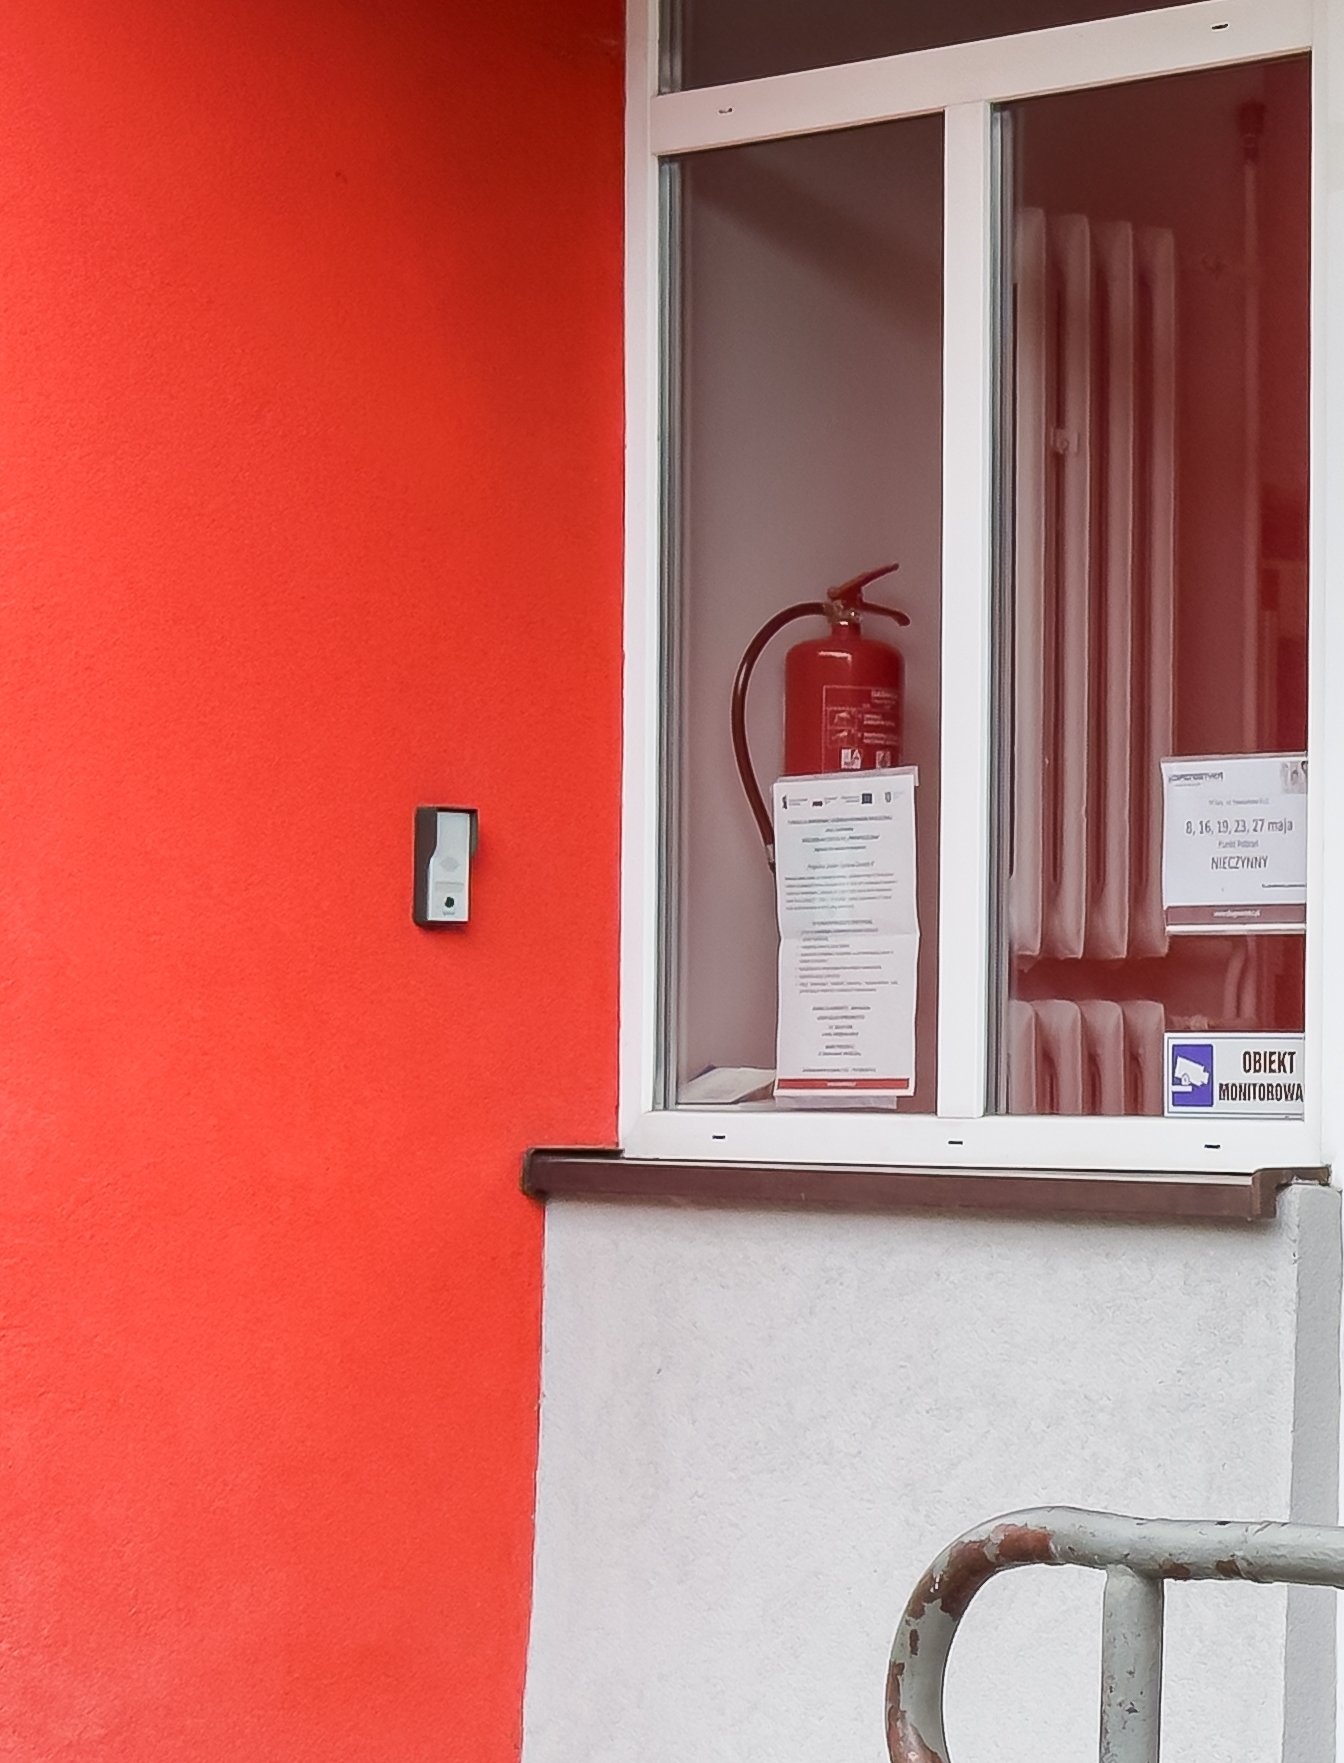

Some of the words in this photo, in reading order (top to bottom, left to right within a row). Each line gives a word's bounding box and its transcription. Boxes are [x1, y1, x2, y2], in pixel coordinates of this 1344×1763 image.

[1186, 820, 1196, 836] 8,
[1199, 820, 1214, 835] 16,
[1217, 819, 1231, 835] 19,
[1253, 818, 1264, 832] 27
[1268, 818, 1293, 834] maja
[1211, 856, 1268, 870] NIECZYNNY
[1242, 1050, 1296, 1074] OBIEKT
[1219, 1082, 1304, 1102] MONITOROWA
